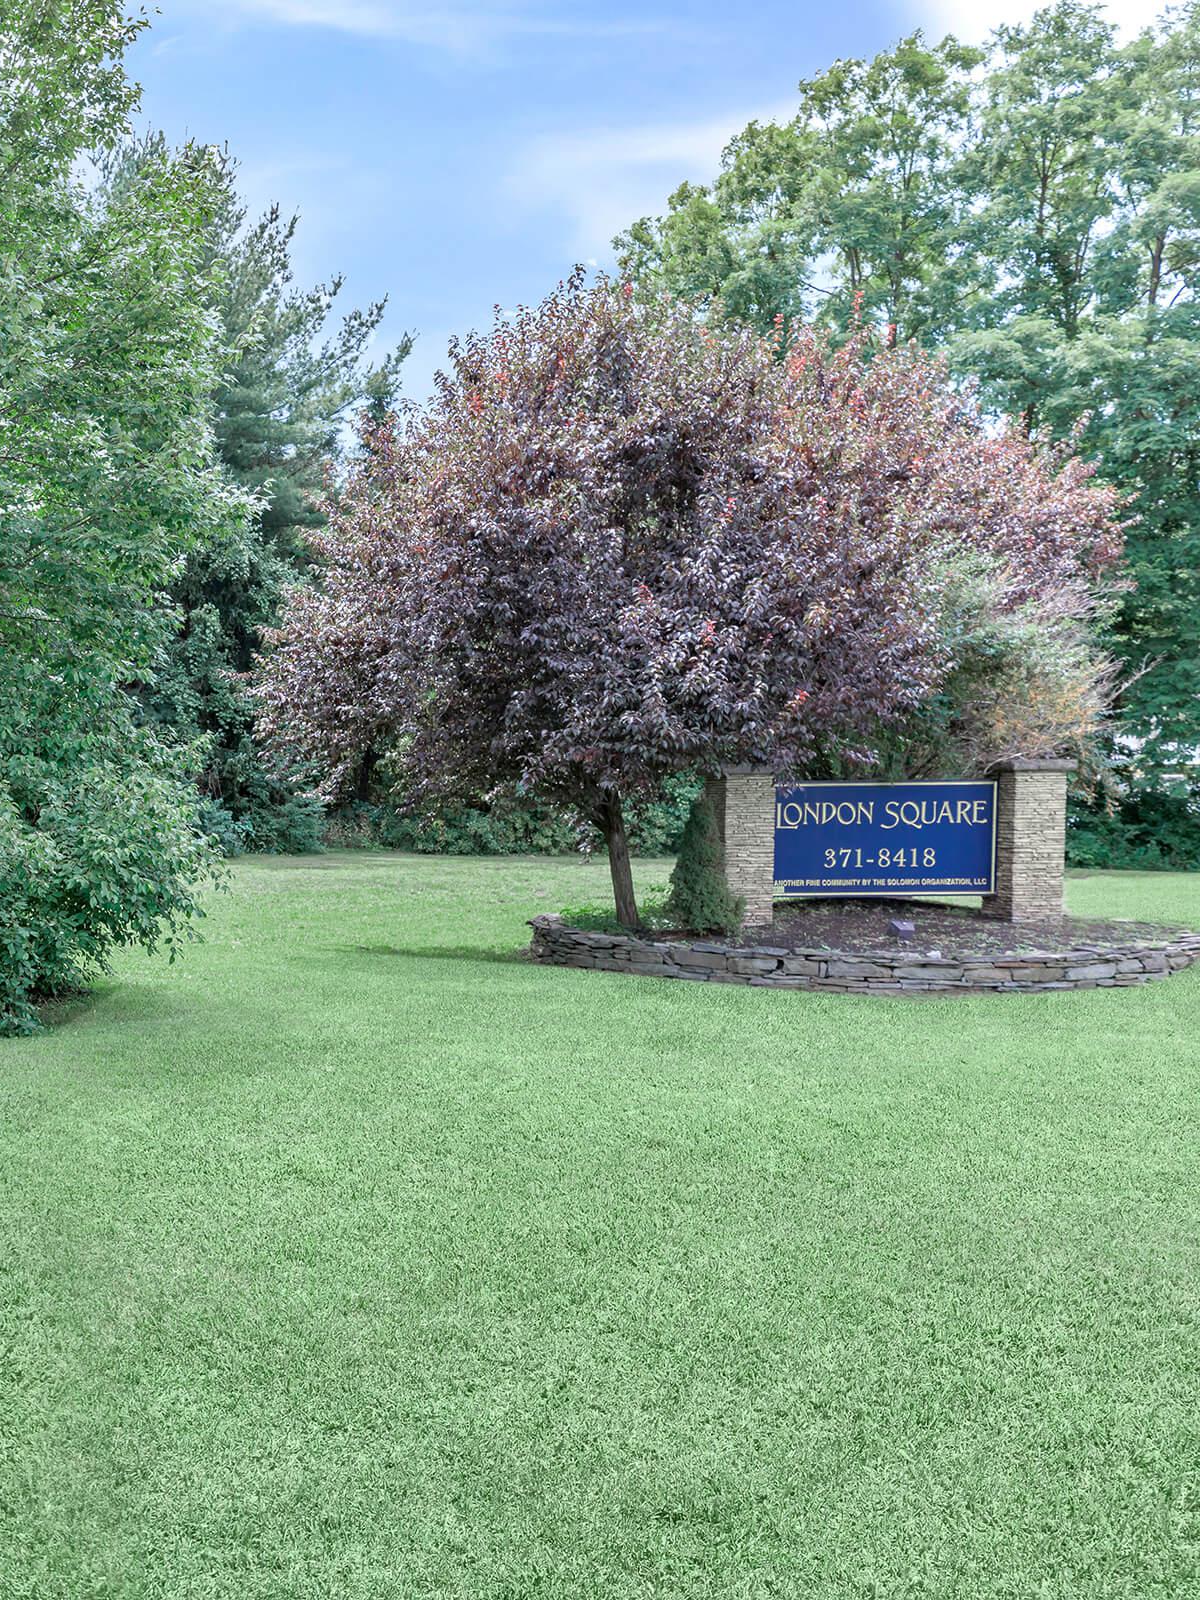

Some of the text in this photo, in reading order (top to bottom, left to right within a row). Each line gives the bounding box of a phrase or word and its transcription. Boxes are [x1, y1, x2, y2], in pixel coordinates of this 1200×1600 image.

[776, 800, 988, 829] LONDON SQUARE
[823, 847, 937, 868] 371-8418
[774, 879, 804, 887] ANOTHER
[821, 879, 861, 887] COMMUNITY
[873, 878, 886, 886] THE
